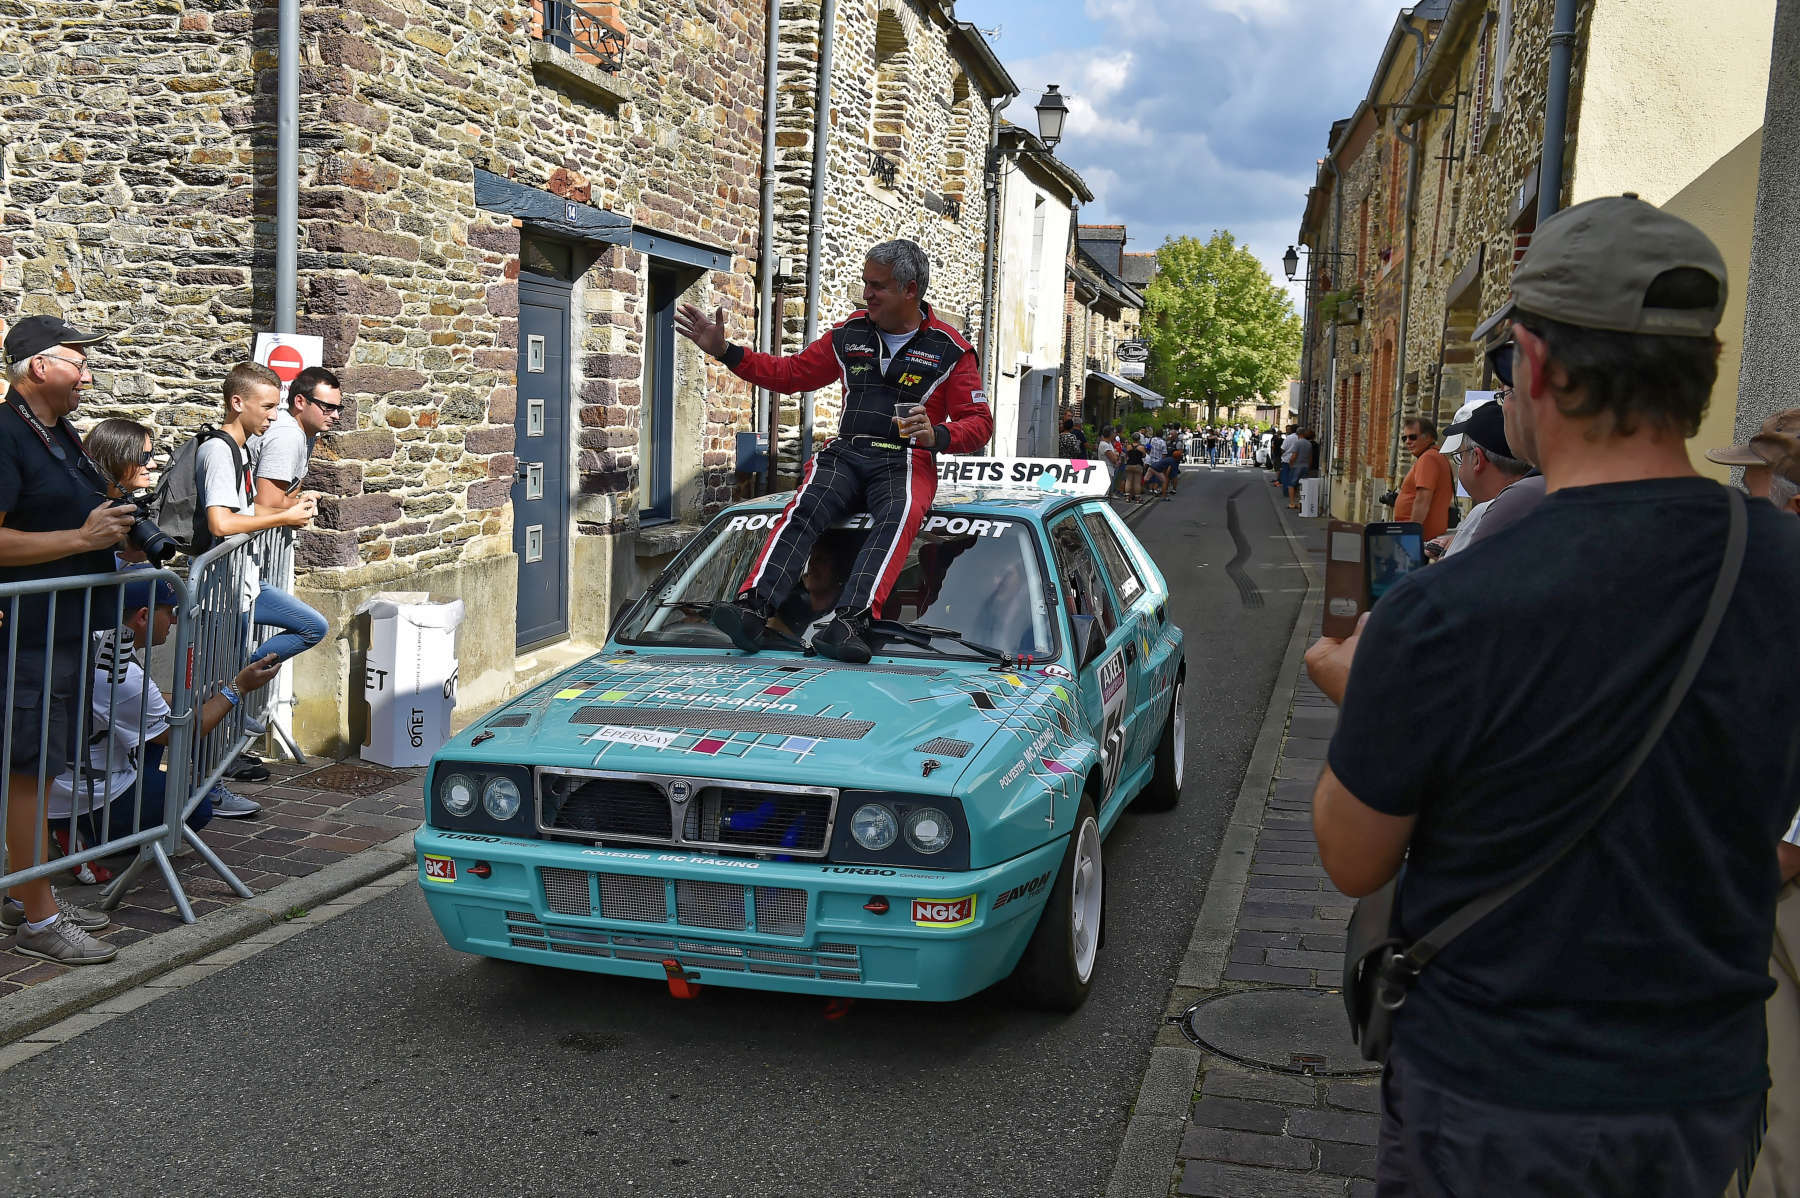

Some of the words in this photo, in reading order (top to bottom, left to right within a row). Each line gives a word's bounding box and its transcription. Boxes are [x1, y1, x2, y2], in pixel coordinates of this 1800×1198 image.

[568, 204, 576, 219] 14
[1010, 462, 1097, 484] SPORT
[1103, 655, 1122, 689] AXEL
[600, 728, 673, 746] EPERNAY
[999, 759, 1027, 789] POLYESTER
[1023, 747, 1037, 763] MC
[1033, 727, 1055, 756] RACING
[436, 831, 502, 844] TURBO
[581, 849, 651, 860] POLYESTER
[657, 854, 688, 863] MC
[690, 857, 761, 869] RACING
[819, 866, 897, 877] TURBO
[1005, 870, 1051, 904] AVON
[915, 904, 963, 922] NGK
